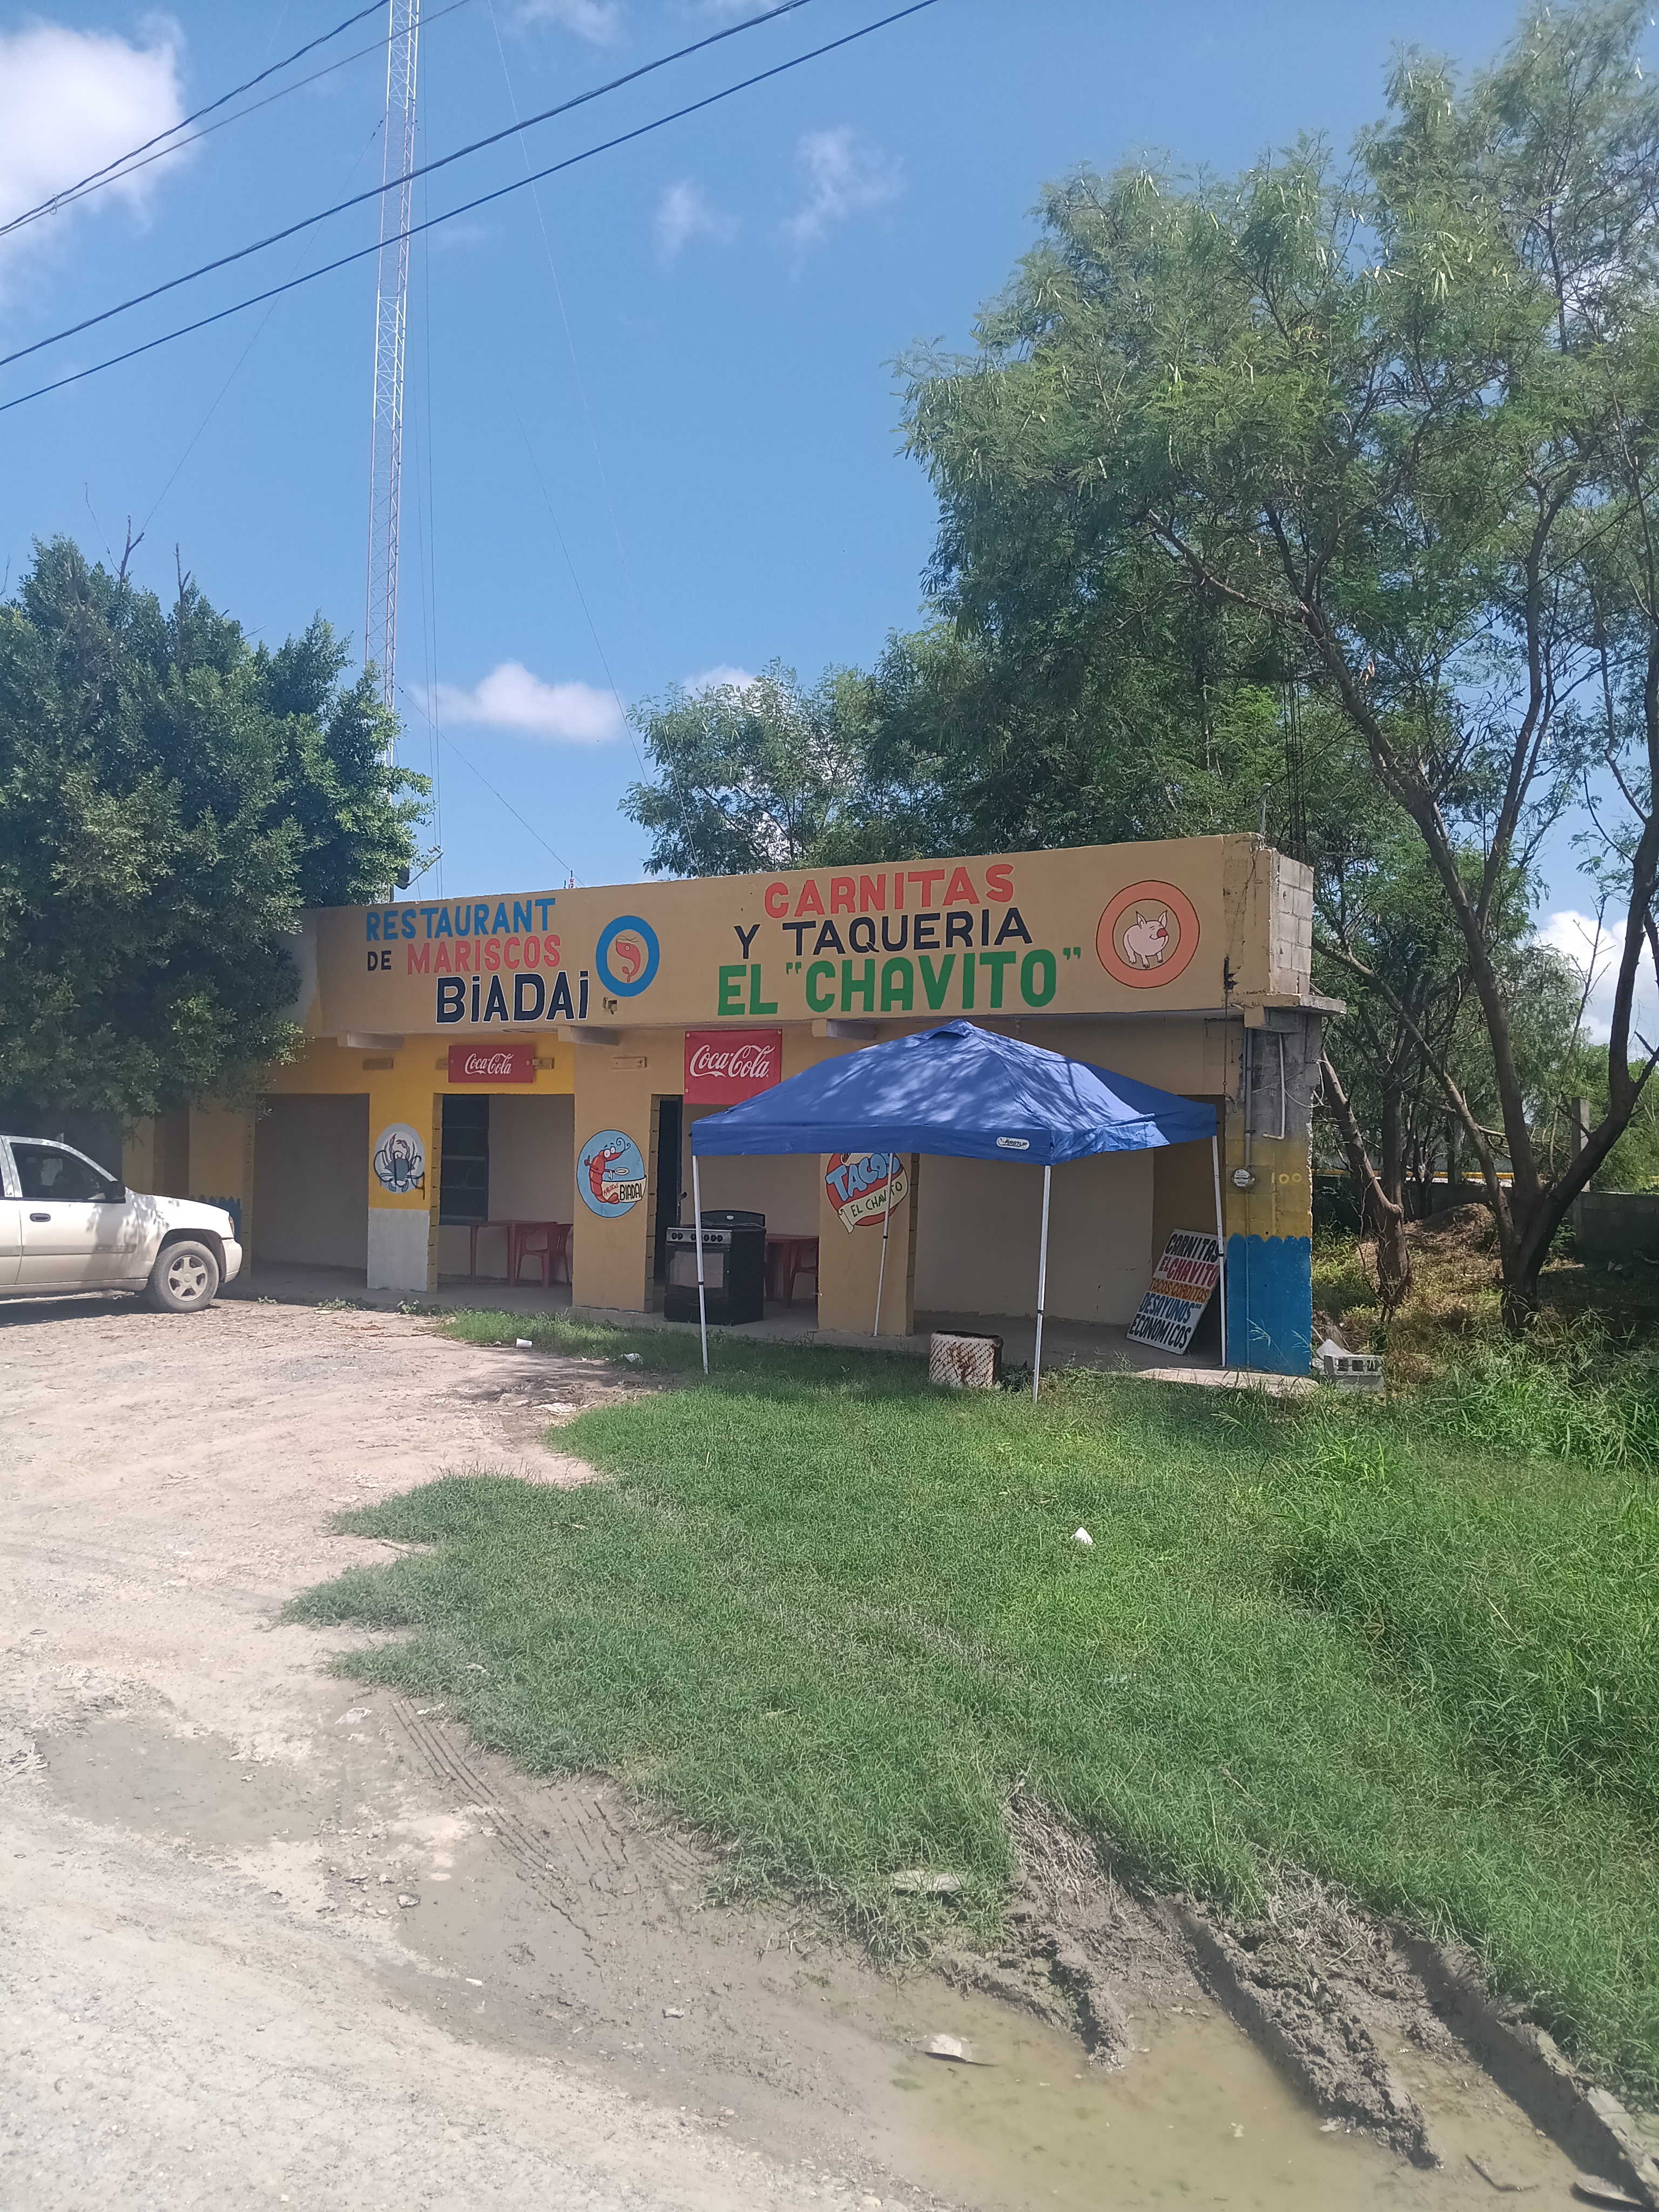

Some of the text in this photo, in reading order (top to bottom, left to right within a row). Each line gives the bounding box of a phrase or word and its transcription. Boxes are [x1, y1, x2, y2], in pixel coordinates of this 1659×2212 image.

[764, 864, 1014, 919] CARNITAS
[366, 898, 556, 941] RESTAURANT
[733, 907, 1033, 960] Y TAQUERIA
[367, 934, 562, 975] DE MARISCOS
[718, 947, 1082, 1016] EL "CHAVITO"
[464, 1053, 515, 1075] Coca-Cola
[690, 1044, 776, 1078] Coca-Cola
[619, 1183, 643, 1201] BIADAI
[825, 1153, 900, 1202] TACOS
[851, 1182, 903, 1217] EL CHAVTO
[1165, 1233, 1224, 1263] CARNITAS
[1158, 1256, 1220, 1287] EL CHAVITO
[1129, 1313, 1192, 1349] ECONOMICOS
